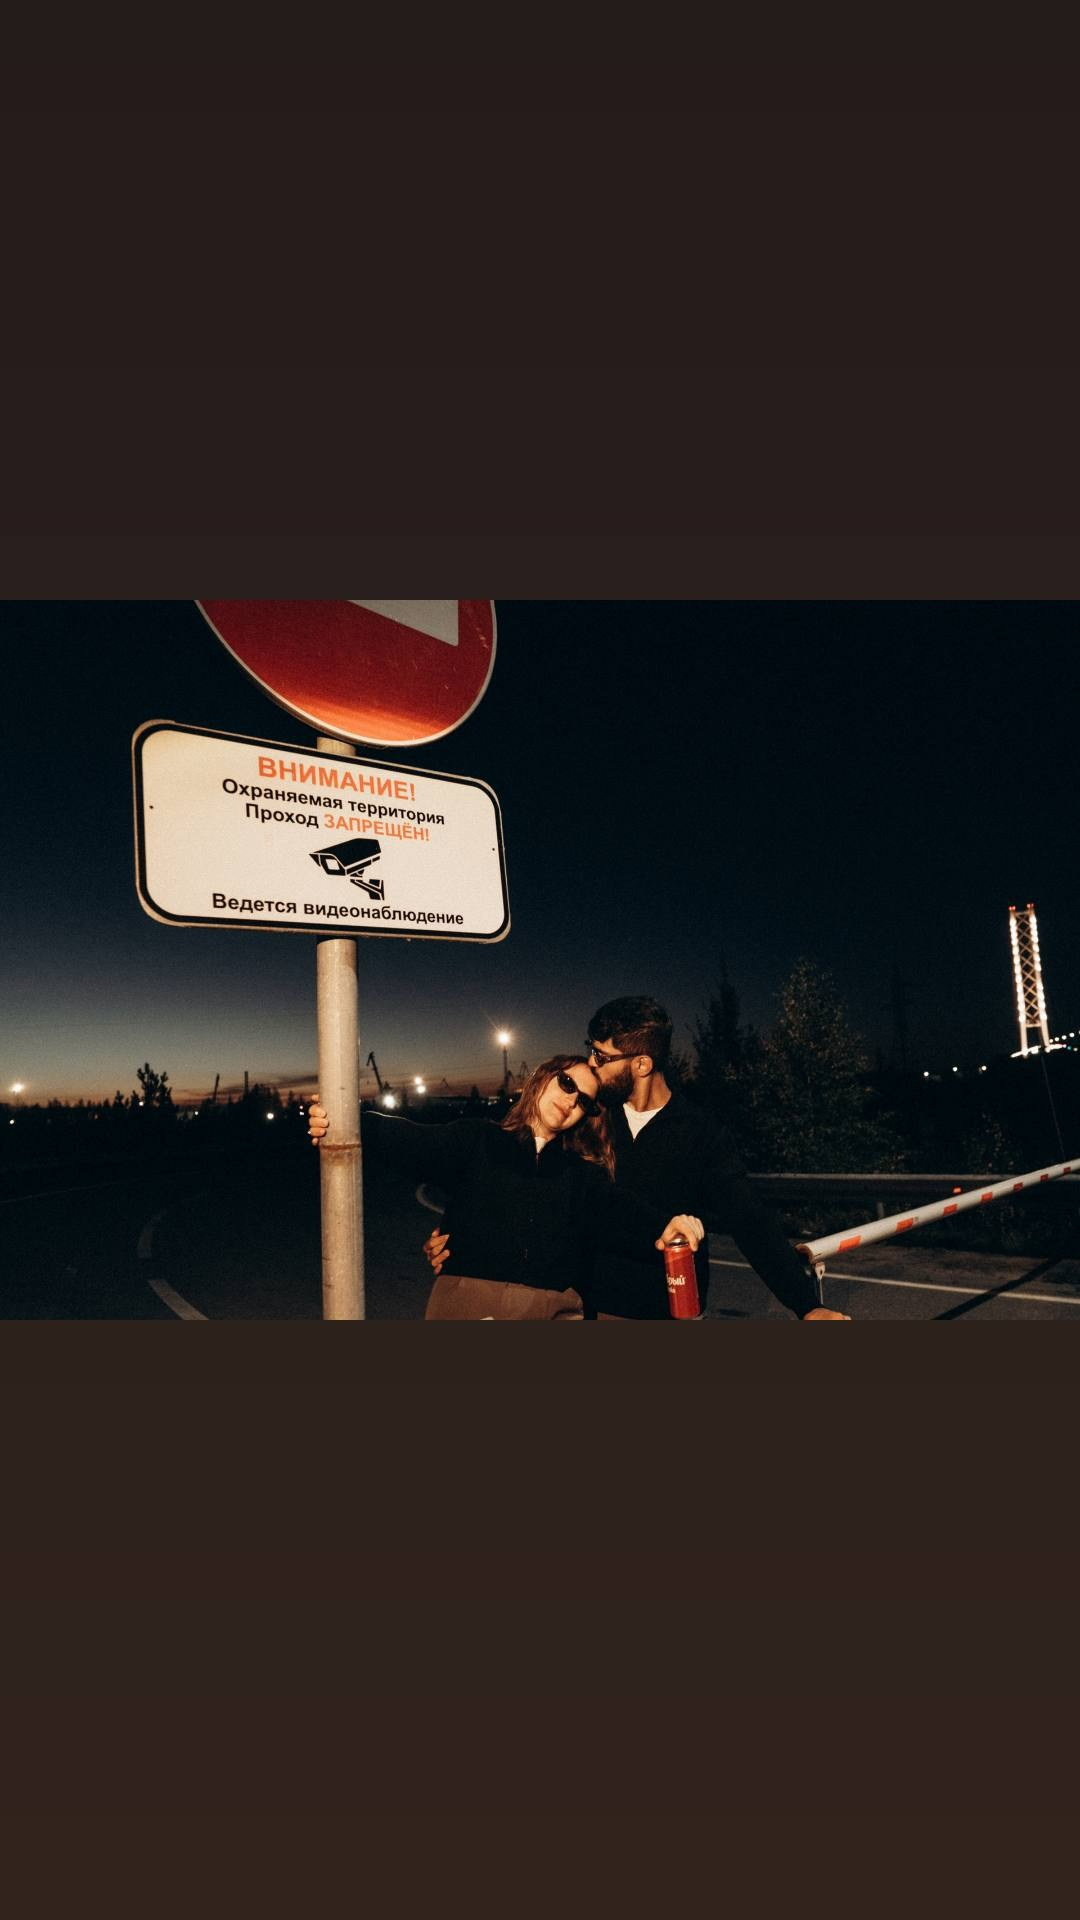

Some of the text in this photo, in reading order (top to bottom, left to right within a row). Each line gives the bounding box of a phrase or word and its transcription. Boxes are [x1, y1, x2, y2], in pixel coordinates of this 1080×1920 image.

[258, 756, 416, 801] ВНИМАНИЕ!
[222, 778, 445, 825] Охраняемая территория
[245, 803, 430, 841] Проход ЗАПРЕЩЁН!
[212, 893, 464, 925] Ведется видеонаблюдение
